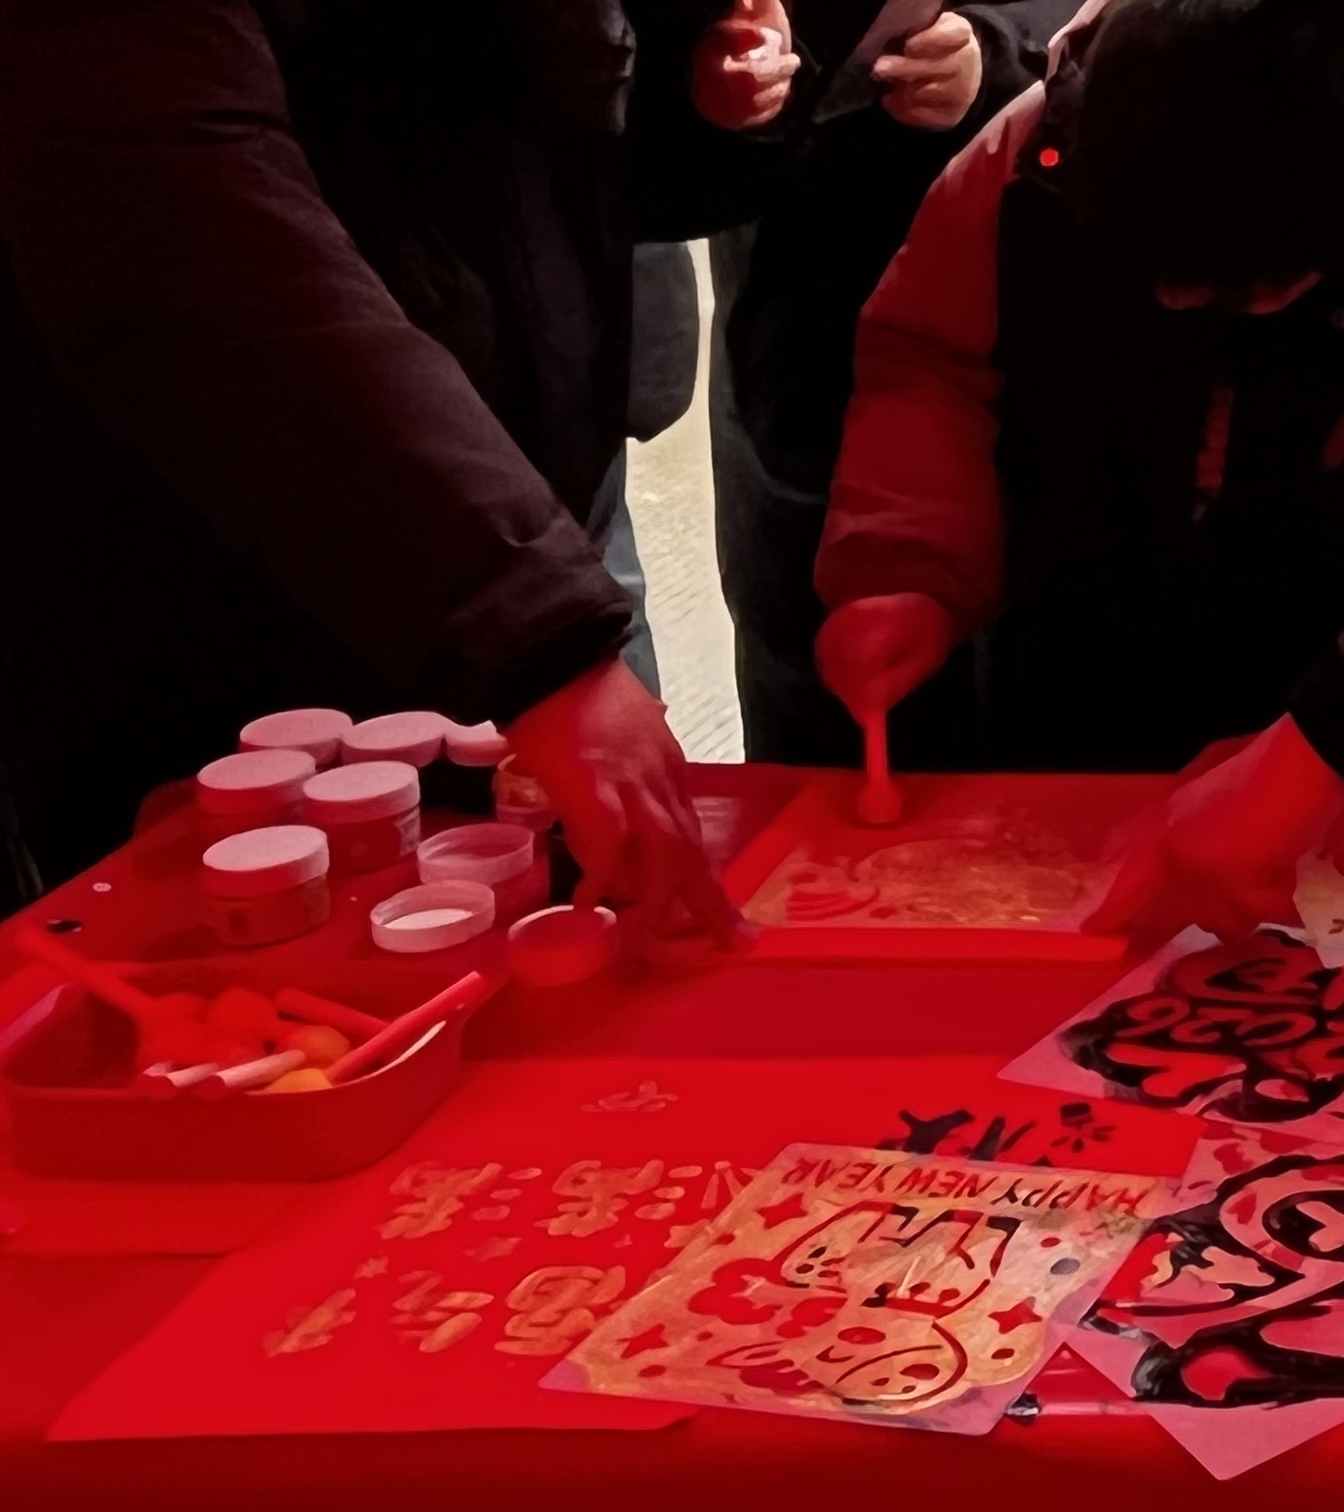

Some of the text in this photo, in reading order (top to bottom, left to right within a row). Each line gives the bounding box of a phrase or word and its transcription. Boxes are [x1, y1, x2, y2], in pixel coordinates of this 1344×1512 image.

[784, 1158, 1144, 1215] HAPPY NEW YEAR
